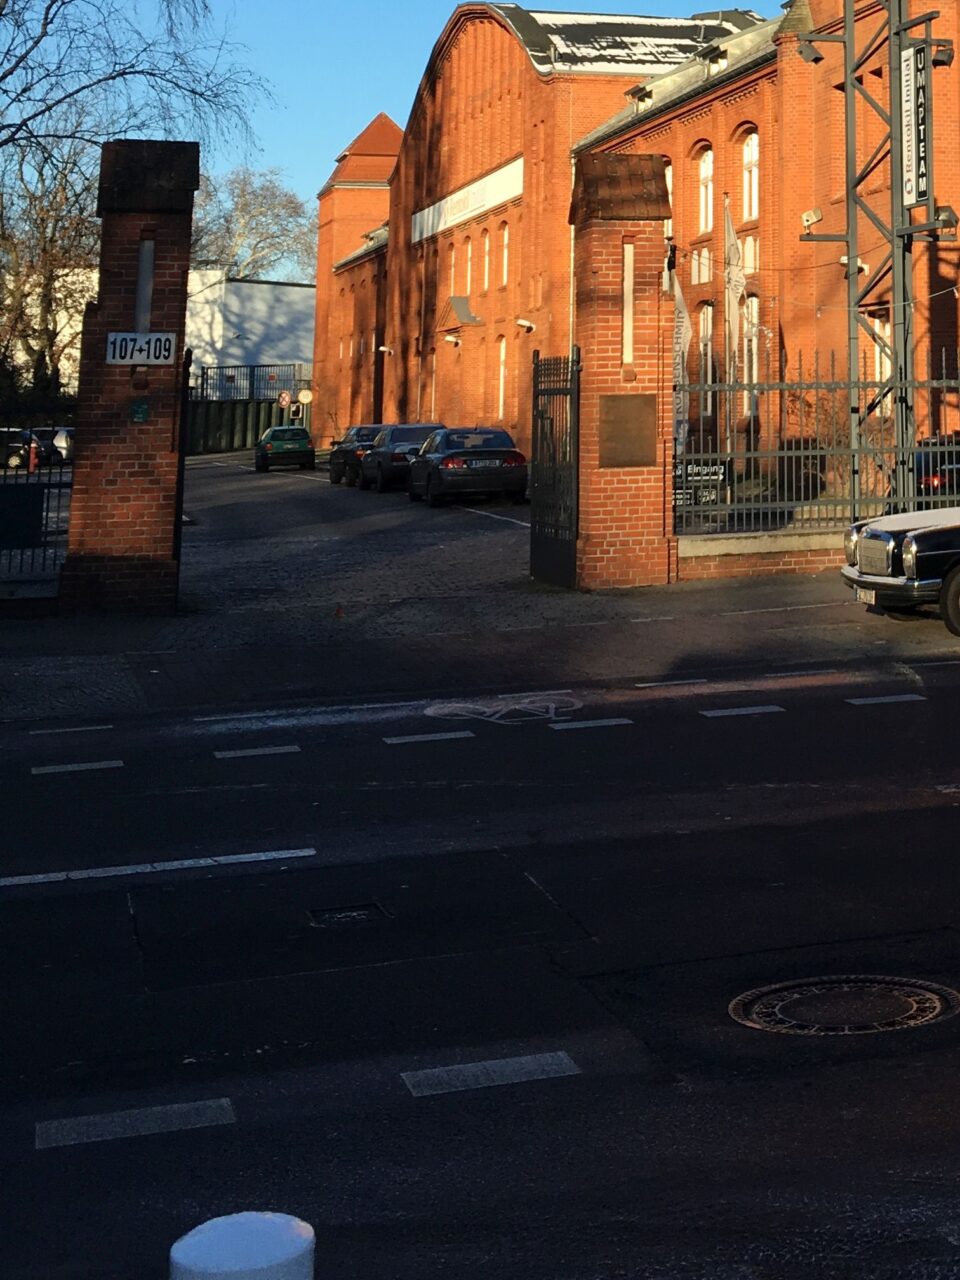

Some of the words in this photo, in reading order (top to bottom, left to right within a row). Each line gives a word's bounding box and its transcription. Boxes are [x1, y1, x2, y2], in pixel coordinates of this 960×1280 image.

[903, 56, 912, 103] Initial
[904, 109, 912, 173] Rentokil
[687, 464, 725, 474] Eingang
